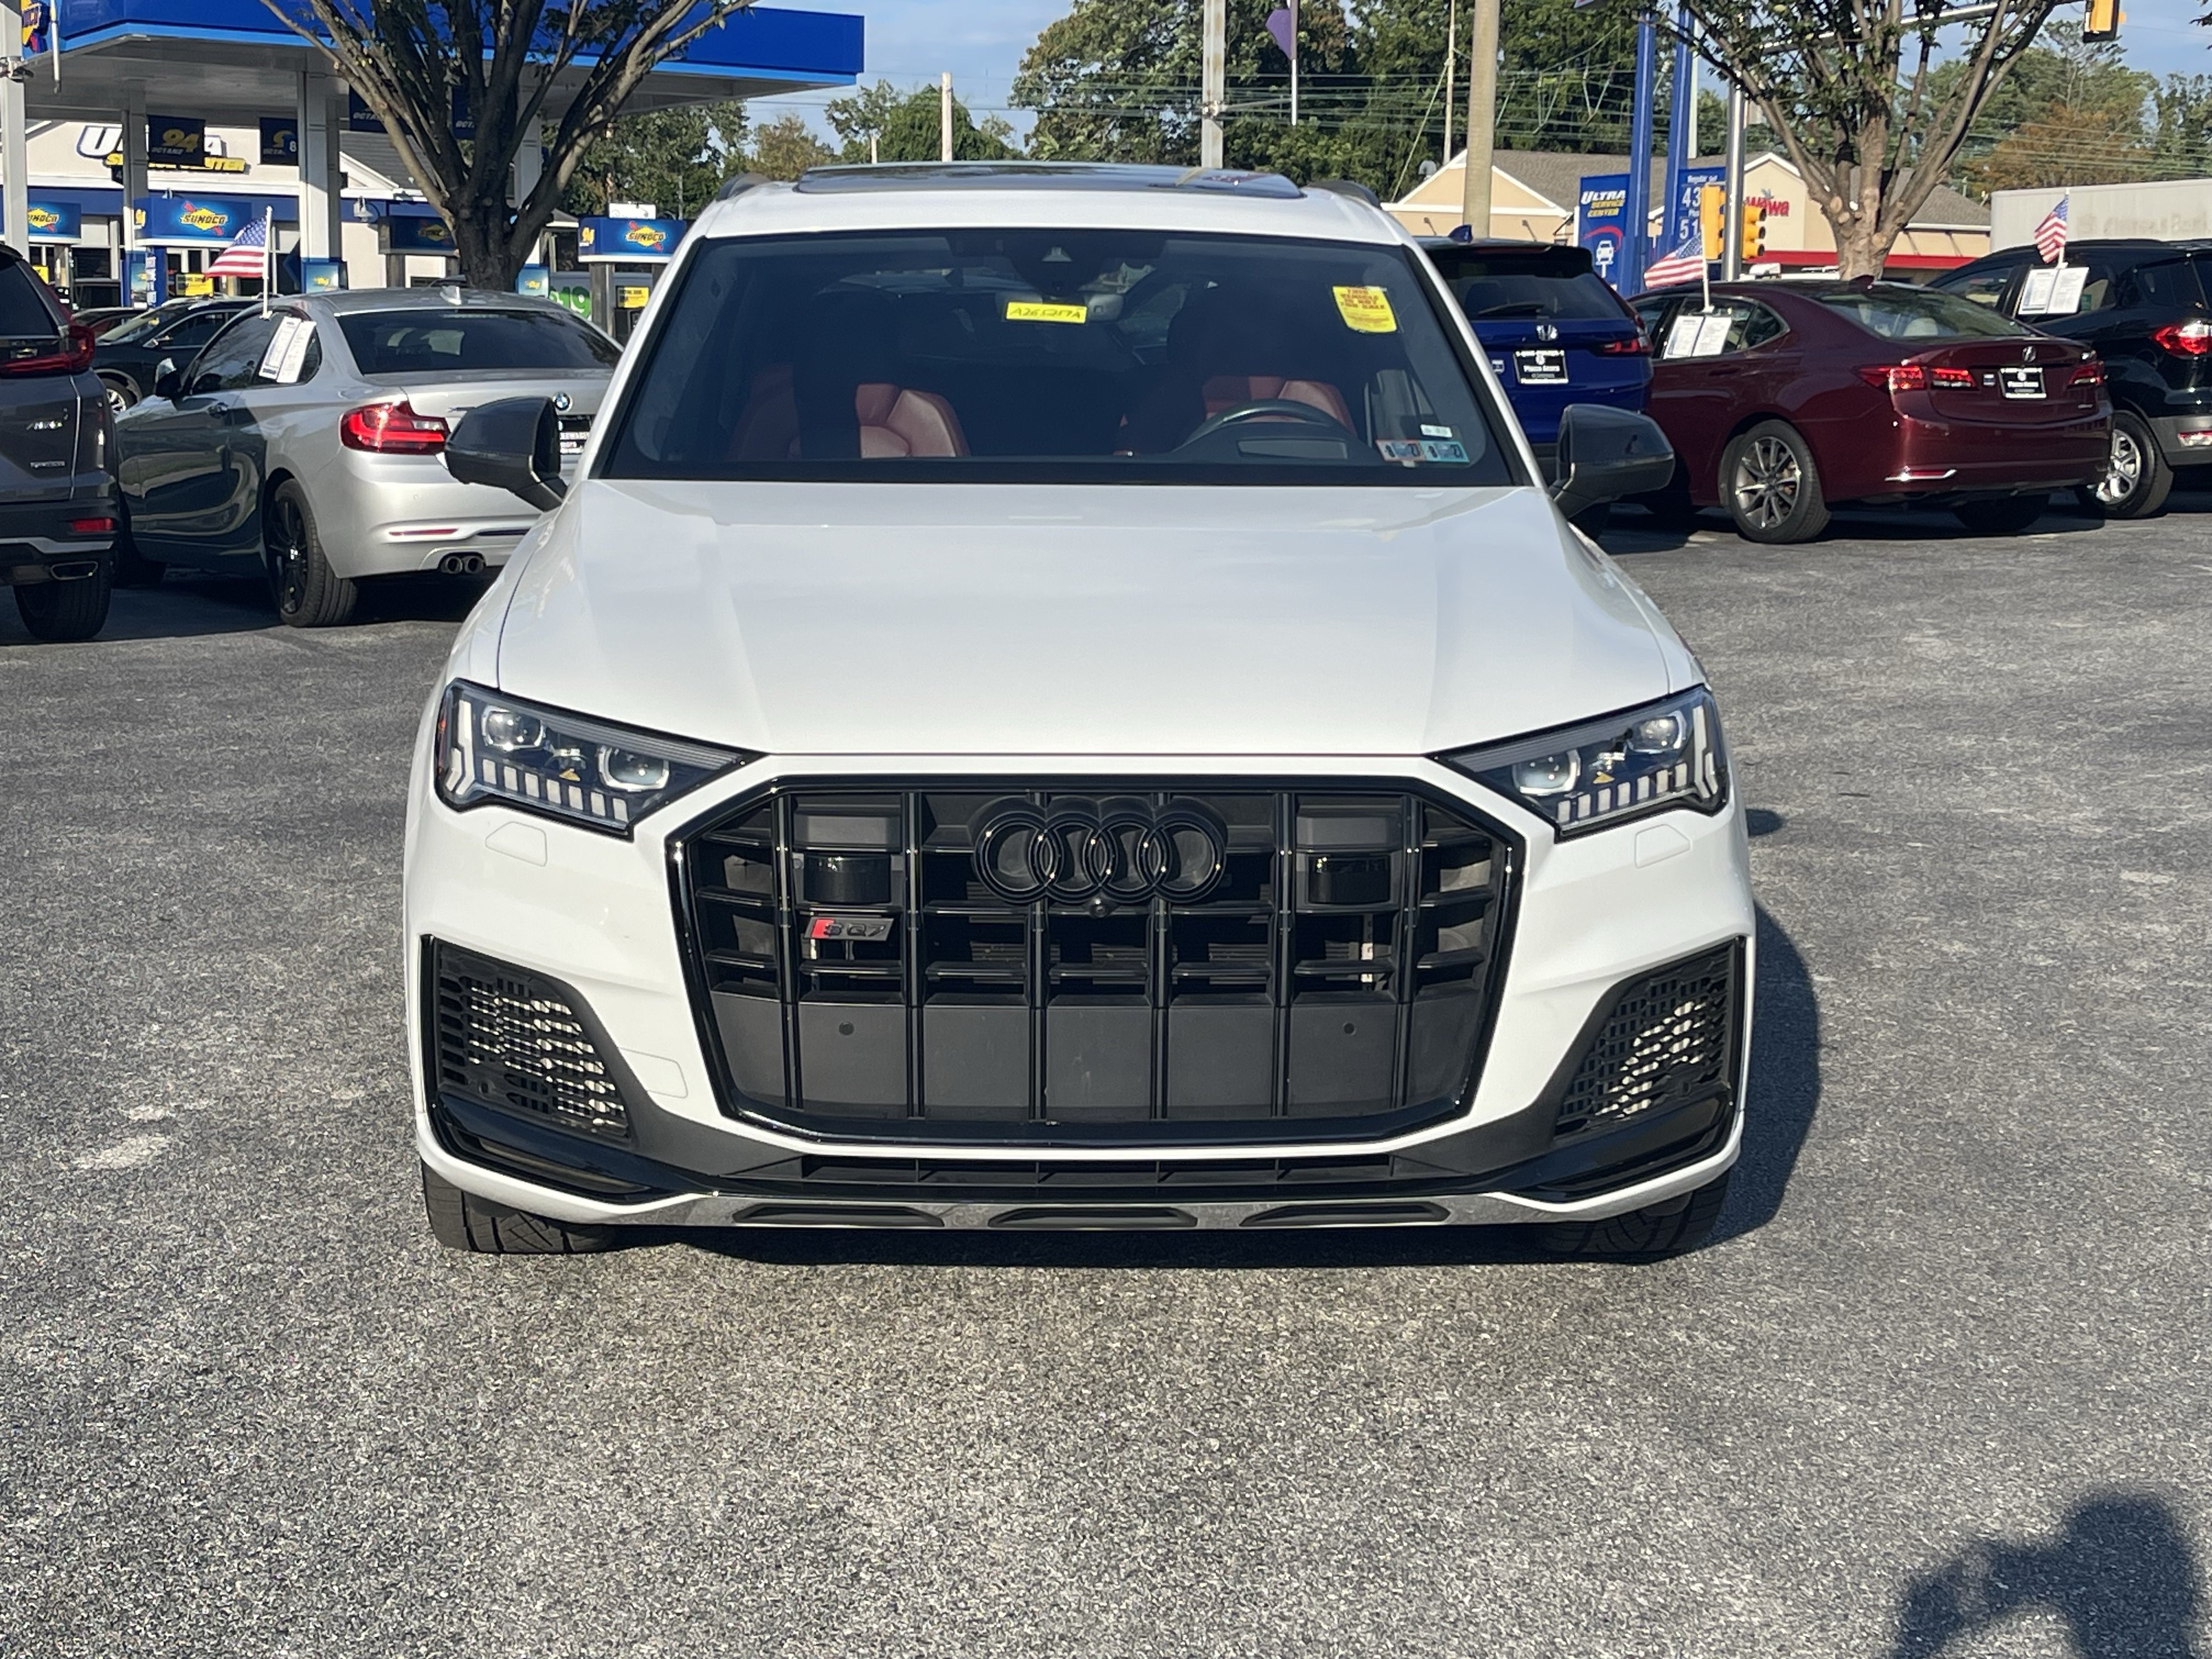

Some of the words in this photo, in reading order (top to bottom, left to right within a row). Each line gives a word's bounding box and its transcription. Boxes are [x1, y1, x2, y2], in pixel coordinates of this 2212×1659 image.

[163, 128, 201, 153] 94
[1581, 190, 1626, 205] ULTRA
[1587, 207, 1620, 218] CENTER
[27, 214, 58, 223] UNOCO
[183, 215, 227, 224] SUNOCO
[628, 232, 664, 241] SUNOCO
[823, 923, 886, 937] SQ7
